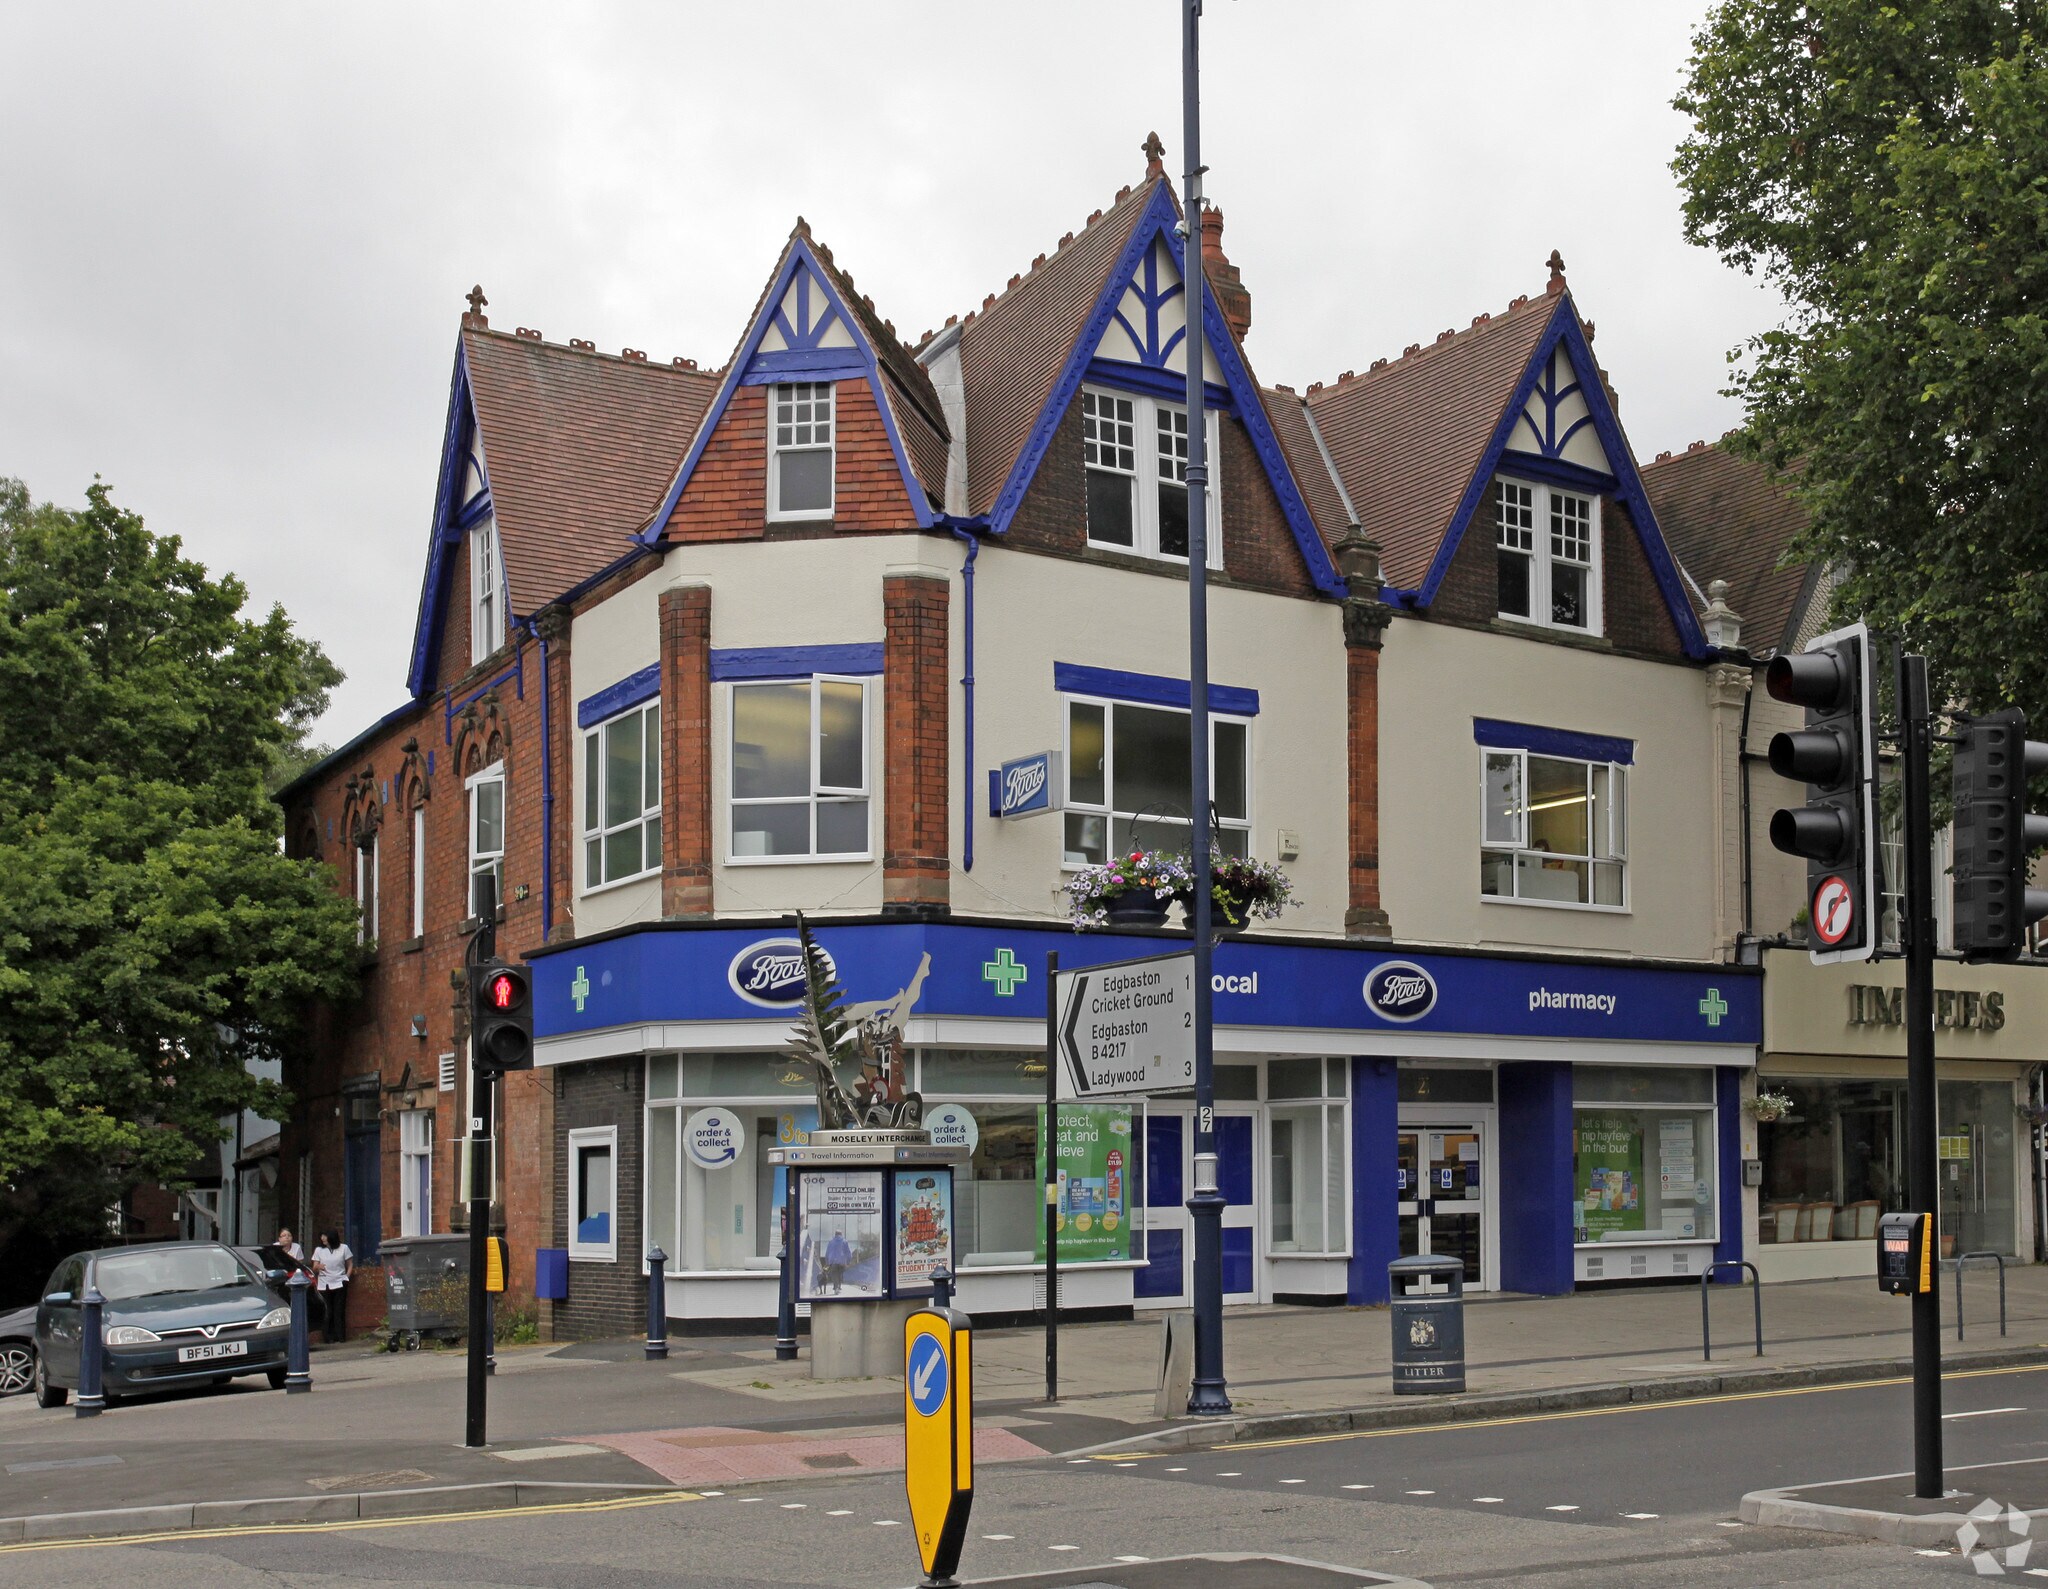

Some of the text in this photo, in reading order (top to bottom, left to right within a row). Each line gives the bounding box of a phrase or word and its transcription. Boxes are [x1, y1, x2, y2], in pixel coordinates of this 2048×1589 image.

[1003, 762, 1044, 810] Boots
[1104, 972, 1190, 994] Edgbaston 1
[1211, 972, 1258, 994] ocal
[1378, 975, 1426, 1006] Boots
[1092, 988, 1174, 1014] Cricket Ground
[1529, 987, 1616, 1015] pharmacy
[1092, 1012, 1191, 1041] Edgbaston 2
[1092, 1061, 1191, 1087] Ladywood 3
[780, 1113, 794, 1143] 3
[934, 1126, 958, 1134] order
[1582, 1117, 1622, 1131] let's help
[696, 1128, 731, 1137] order &
[935, 1135, 965, 1143] collect
[1076, 1129, 1098, 1141] and
[1582, 1130, 1632, 1143] nip hayfeve
[697, 1138, 730, 1147] collect
[1582, 1142, 1628, 1153] in the bud
[1043, 1144, 1084, 1157] rlieve
[1887, 1241, 1908, 1252] WAIT
[898, 1264, 925, 1272] STUDENT
[187, 1344, 240, 1359] BF51 JKJ
[1404, 1367, 1445, 1376] LITTER
